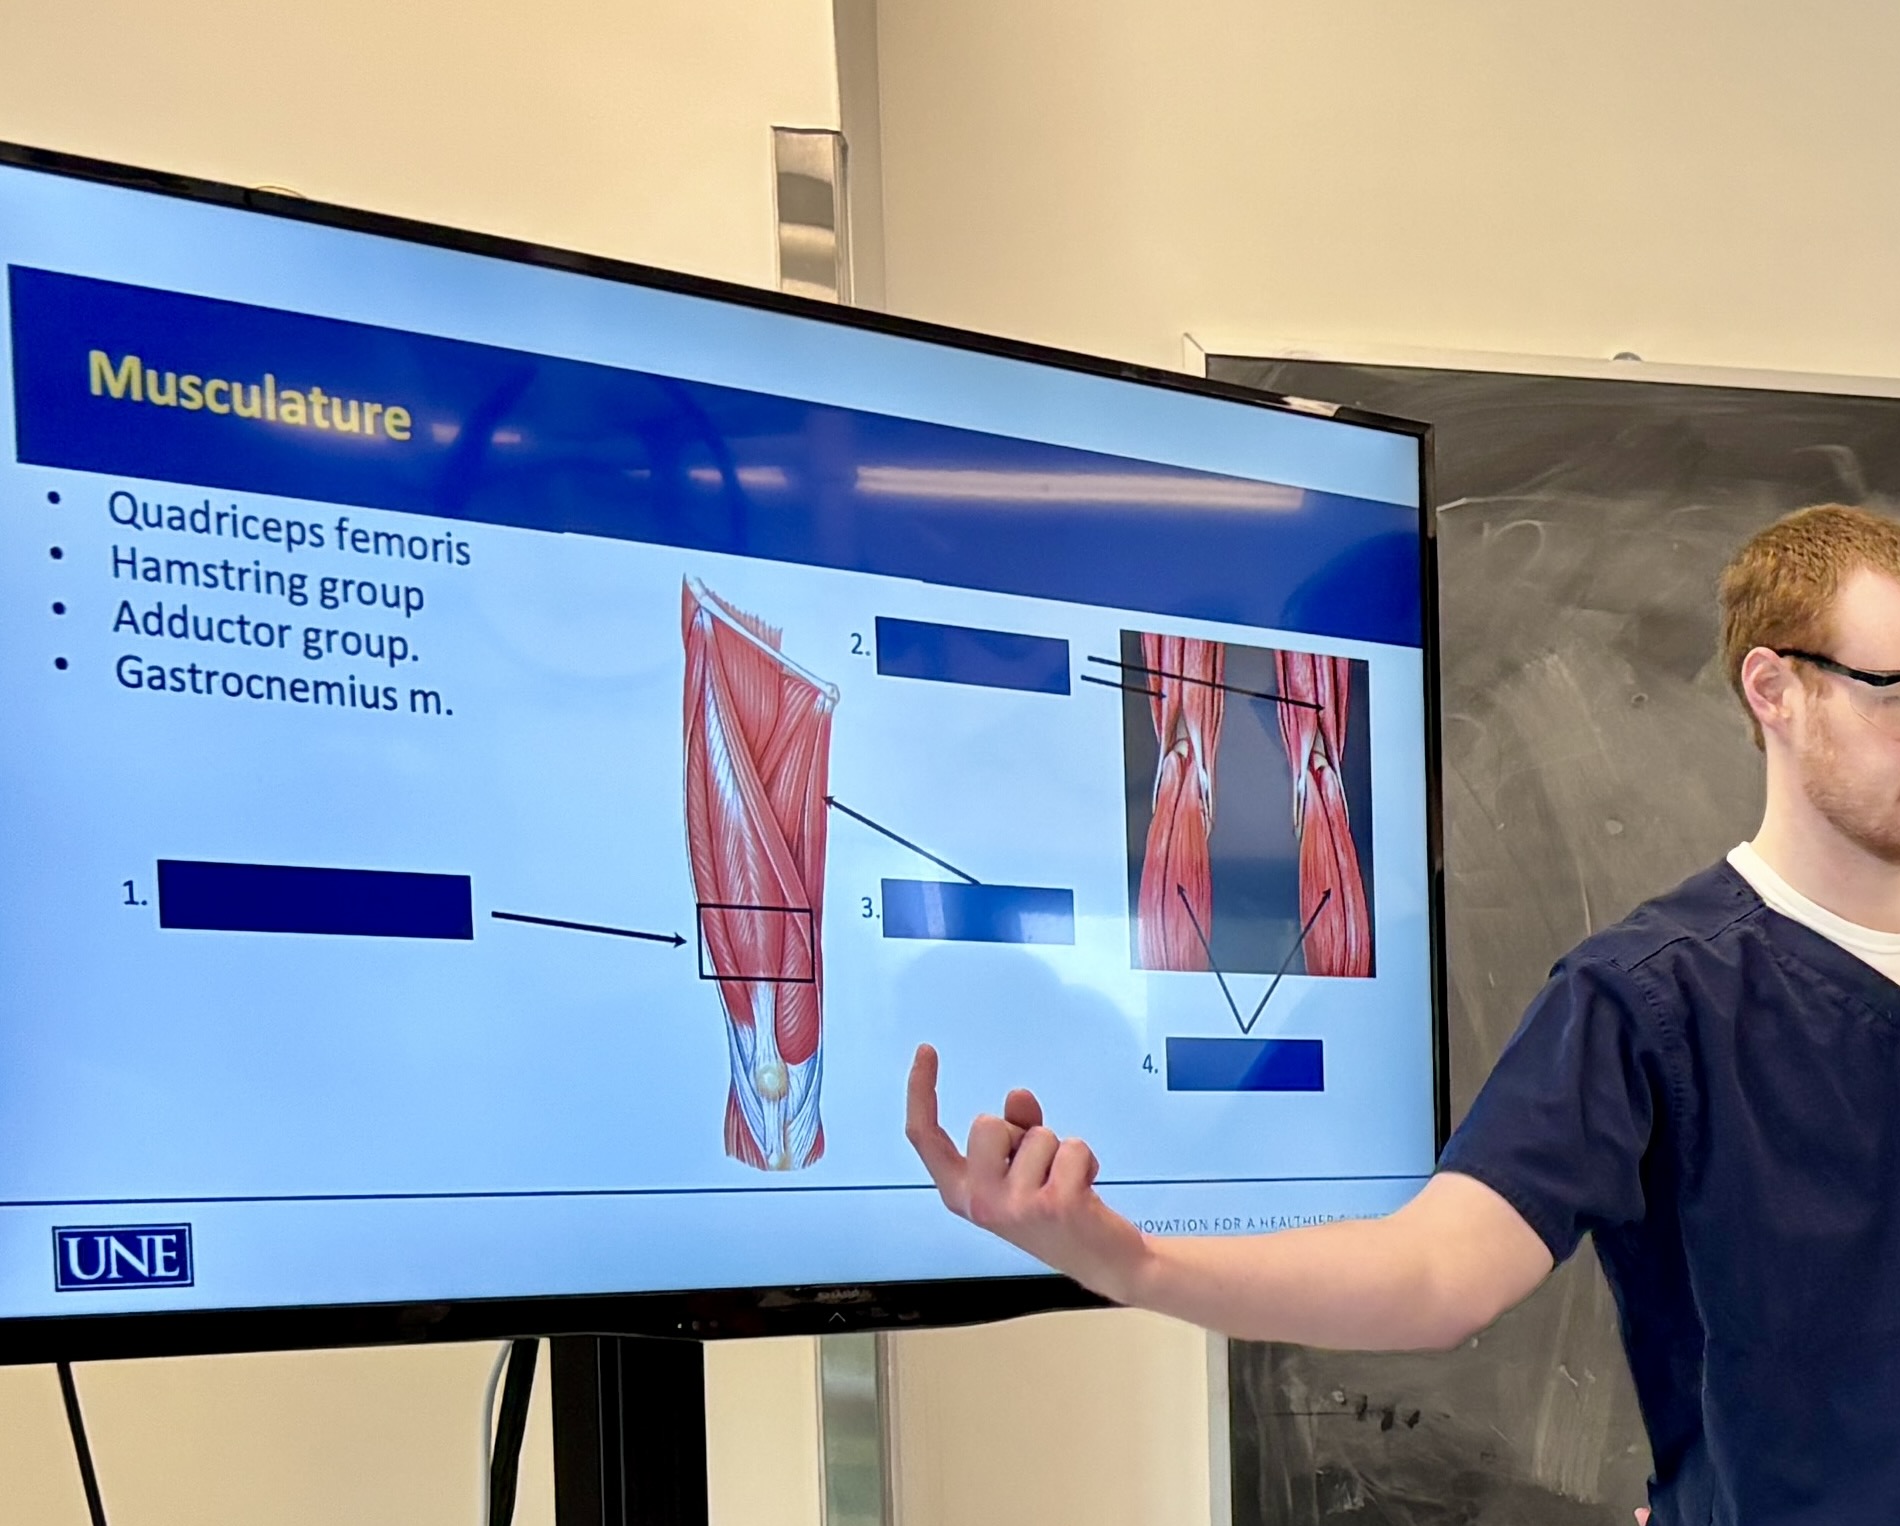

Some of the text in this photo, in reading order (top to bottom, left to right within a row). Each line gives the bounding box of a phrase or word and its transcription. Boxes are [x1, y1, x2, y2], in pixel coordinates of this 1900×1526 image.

[89, 350, 412, 440] Musculature
[108, 491, 471, 566] Quadriceps femoris
[111, 545, 425, 618] Hamstring group
[113, 600, 419, 667] Adductor group.
[850, 632, 871, 656] 2.
[116, 654, 454, 716] Gastrocnemius m.
[123, 879, 148, 906] 1.
[861, 896, 881, 919] 3.
[1142, 1053, 1159, 1074] 4.
[1133, 1218, 1209, 1234] NOVATION
[1214, 1217, 1241, 1231] FOR
[1247, 1217, 1256, 1229] A
[63, 1234, 180, 1280] UNE
